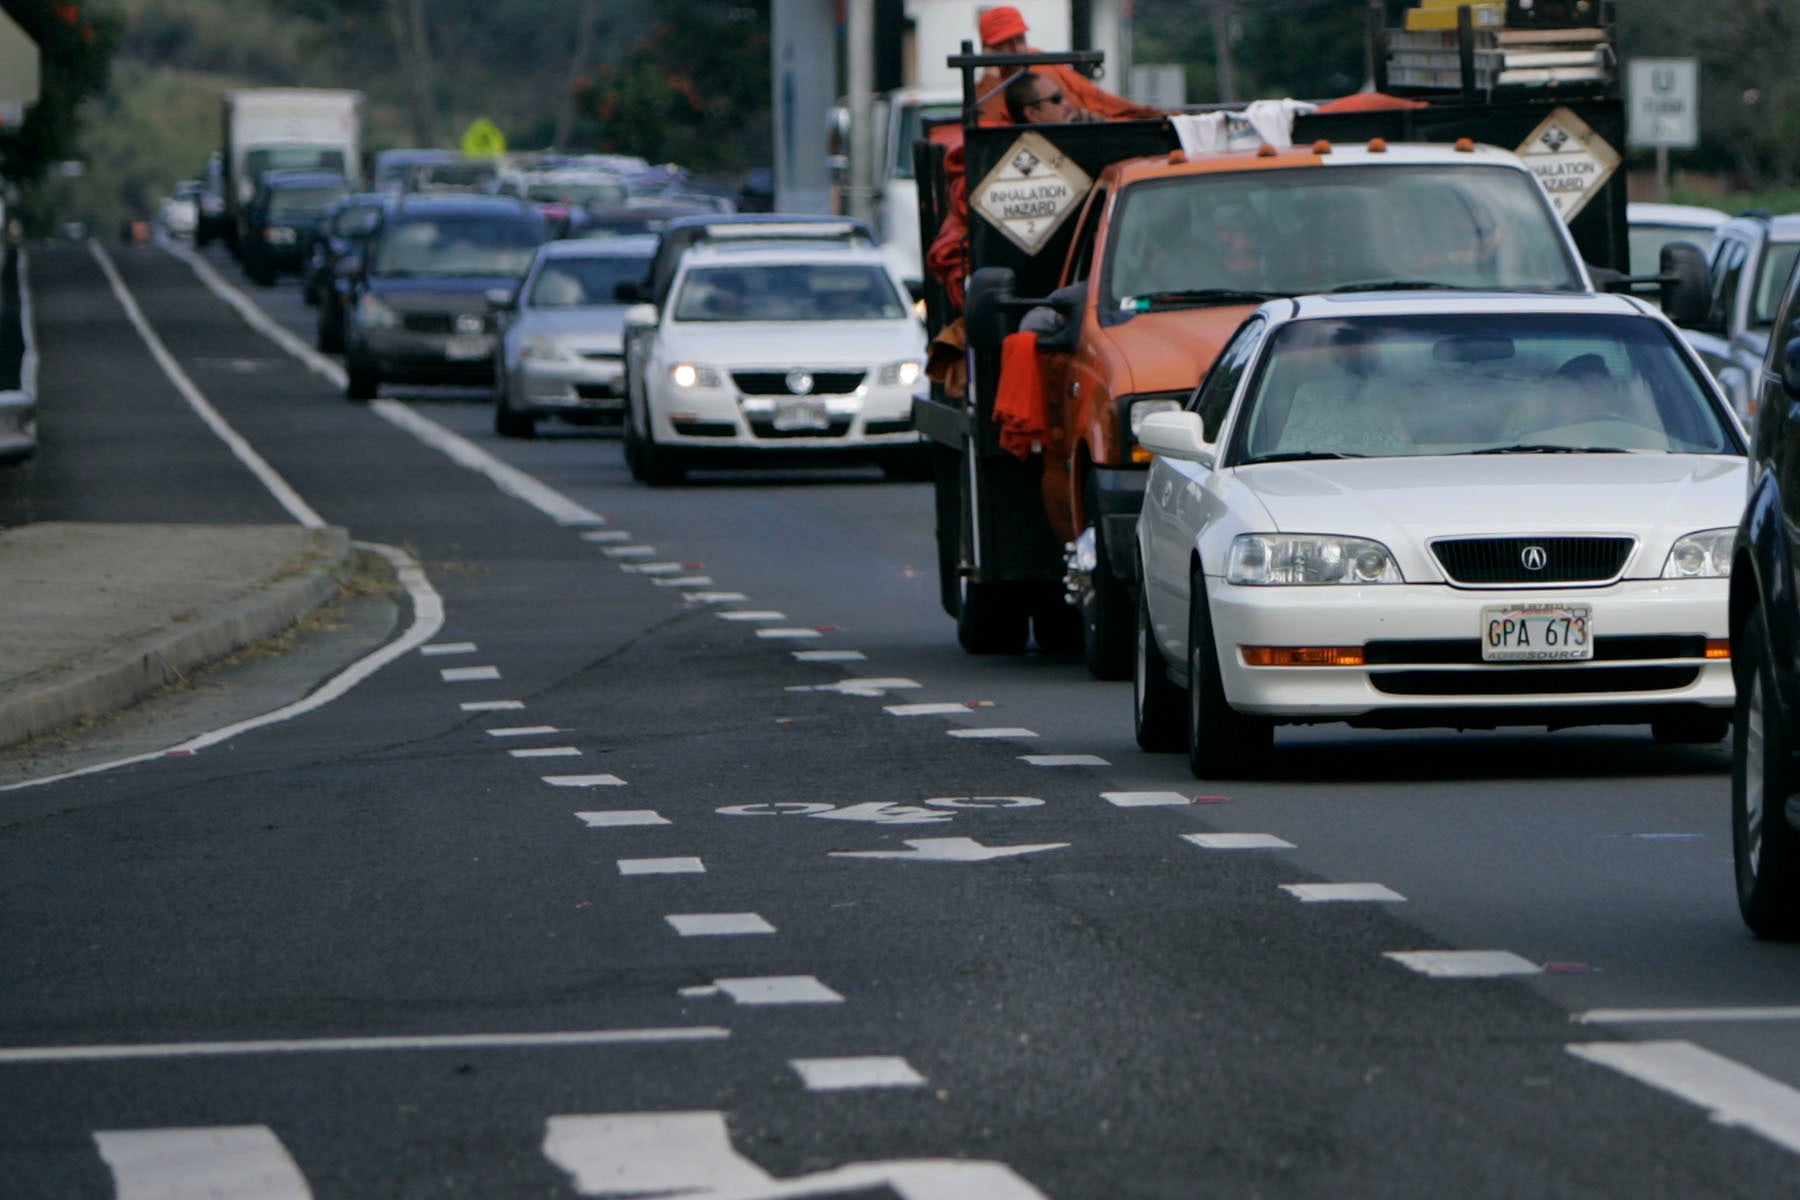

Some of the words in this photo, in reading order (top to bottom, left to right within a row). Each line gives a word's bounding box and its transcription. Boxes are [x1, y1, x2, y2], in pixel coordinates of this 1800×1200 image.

[990, 185, 1067, 202] INHALATION
[1003, 201, 1057, 216] HAZARD
[1489, 619, 1530, 646] GPA
[1545, 617, 1587, 646] 673
